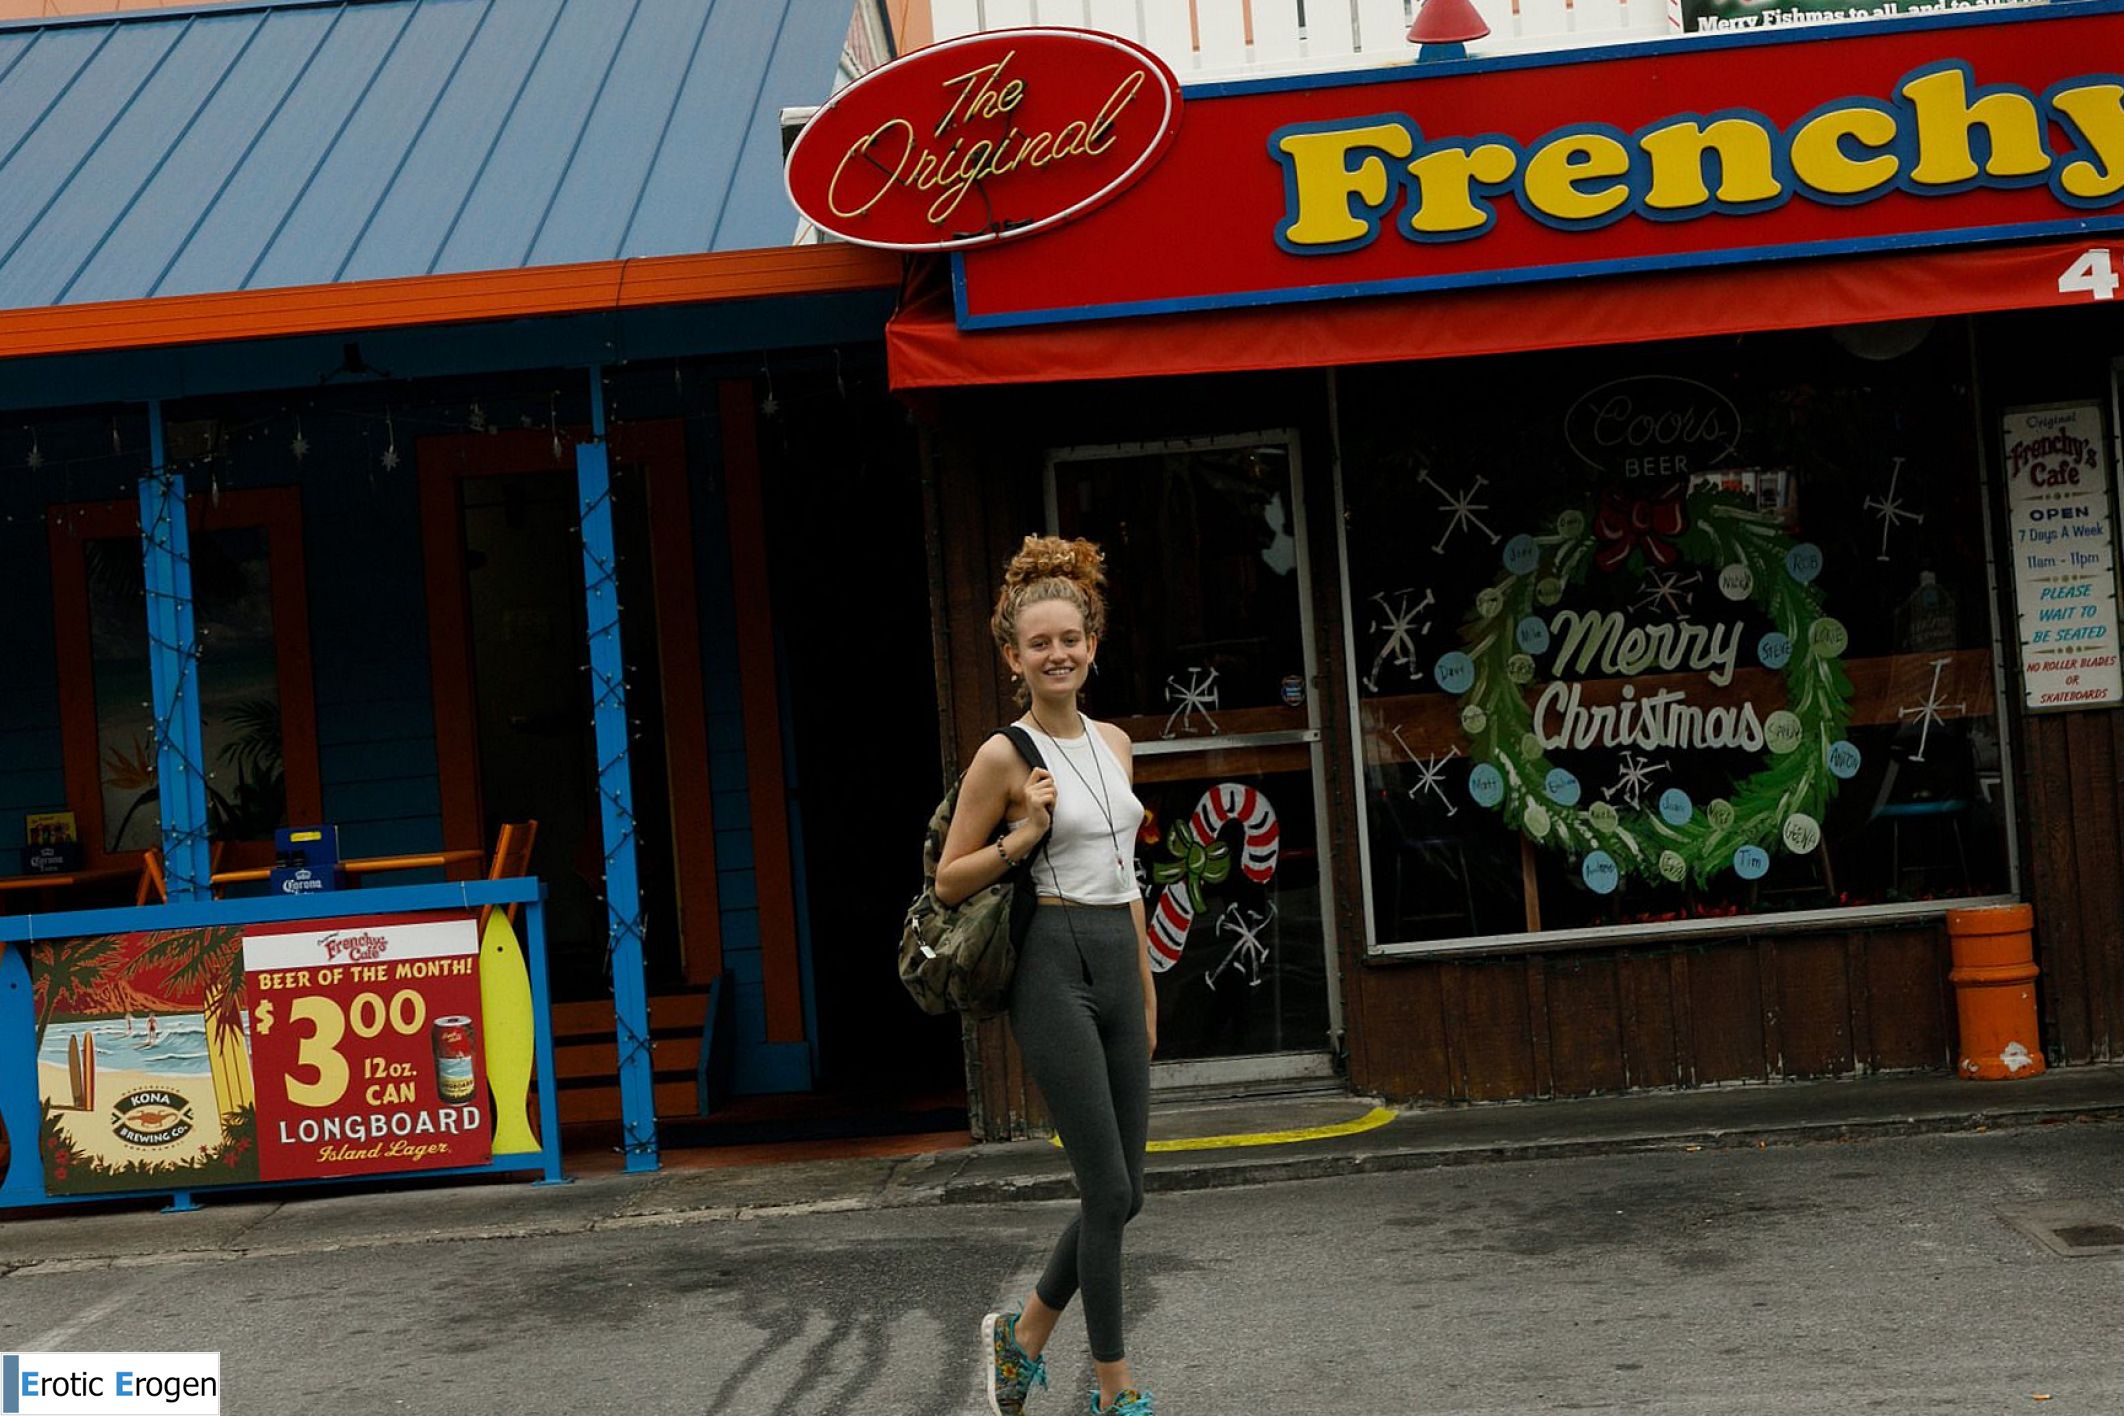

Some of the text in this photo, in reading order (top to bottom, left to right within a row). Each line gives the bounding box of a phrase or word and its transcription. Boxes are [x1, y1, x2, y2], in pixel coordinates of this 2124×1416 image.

[1697, 15, 1759, 33] Merry
[1761, 8, 1845, 26] Fishmas
[942, 50, 1023, 138] The
[829, 70, 1144, 223] Original
[1278, 69, 2124, 245] Frenchy
[2057, 248, 2119, 299] 4
[1590, 394, 1727, 446] Coors
[2026, 411, 2076, 429] Original
[2011, 426, 2097, 479] Frenchy's
[1625, 455, 1688, 478] BEER
[2030, 460, 2080, 487] Cafe
[2030, 506, 2089, 521] OPEN
[2019, 520, 2104, 544] 7 Days A Week
[2040, 584, 2092, 600] PLEASE
[2040, 604, 2097, 622] WAIT TO
[2032, 625, 2107, 643] BE SEATED
[1550, 609, 1744, 687] Merry
[2026, 656, 2117, 673] NO ROLLER BLADES
[2065, 675, 2080, 686] OR
[2040, 688, 2108, 704] SKATEBOARDS
[1533, 681, 1763, 752] Christmas
[1739, 850, 1763, 869] Tim
[281, 879, 323, 893] Corona
[258, 957, 472, 990] BEER OF THE MONTH!
[364, 1057, 417, 1079] 12oz.
[130, 1092, 170, 1106] KONA
[365, 1082, 416, 1106] CAN
[120, 1126, 170, 1143] BREWING
[279, 1107, 480, 1143] LONGBOARD
[317, 1142, 381, 1162] Island
